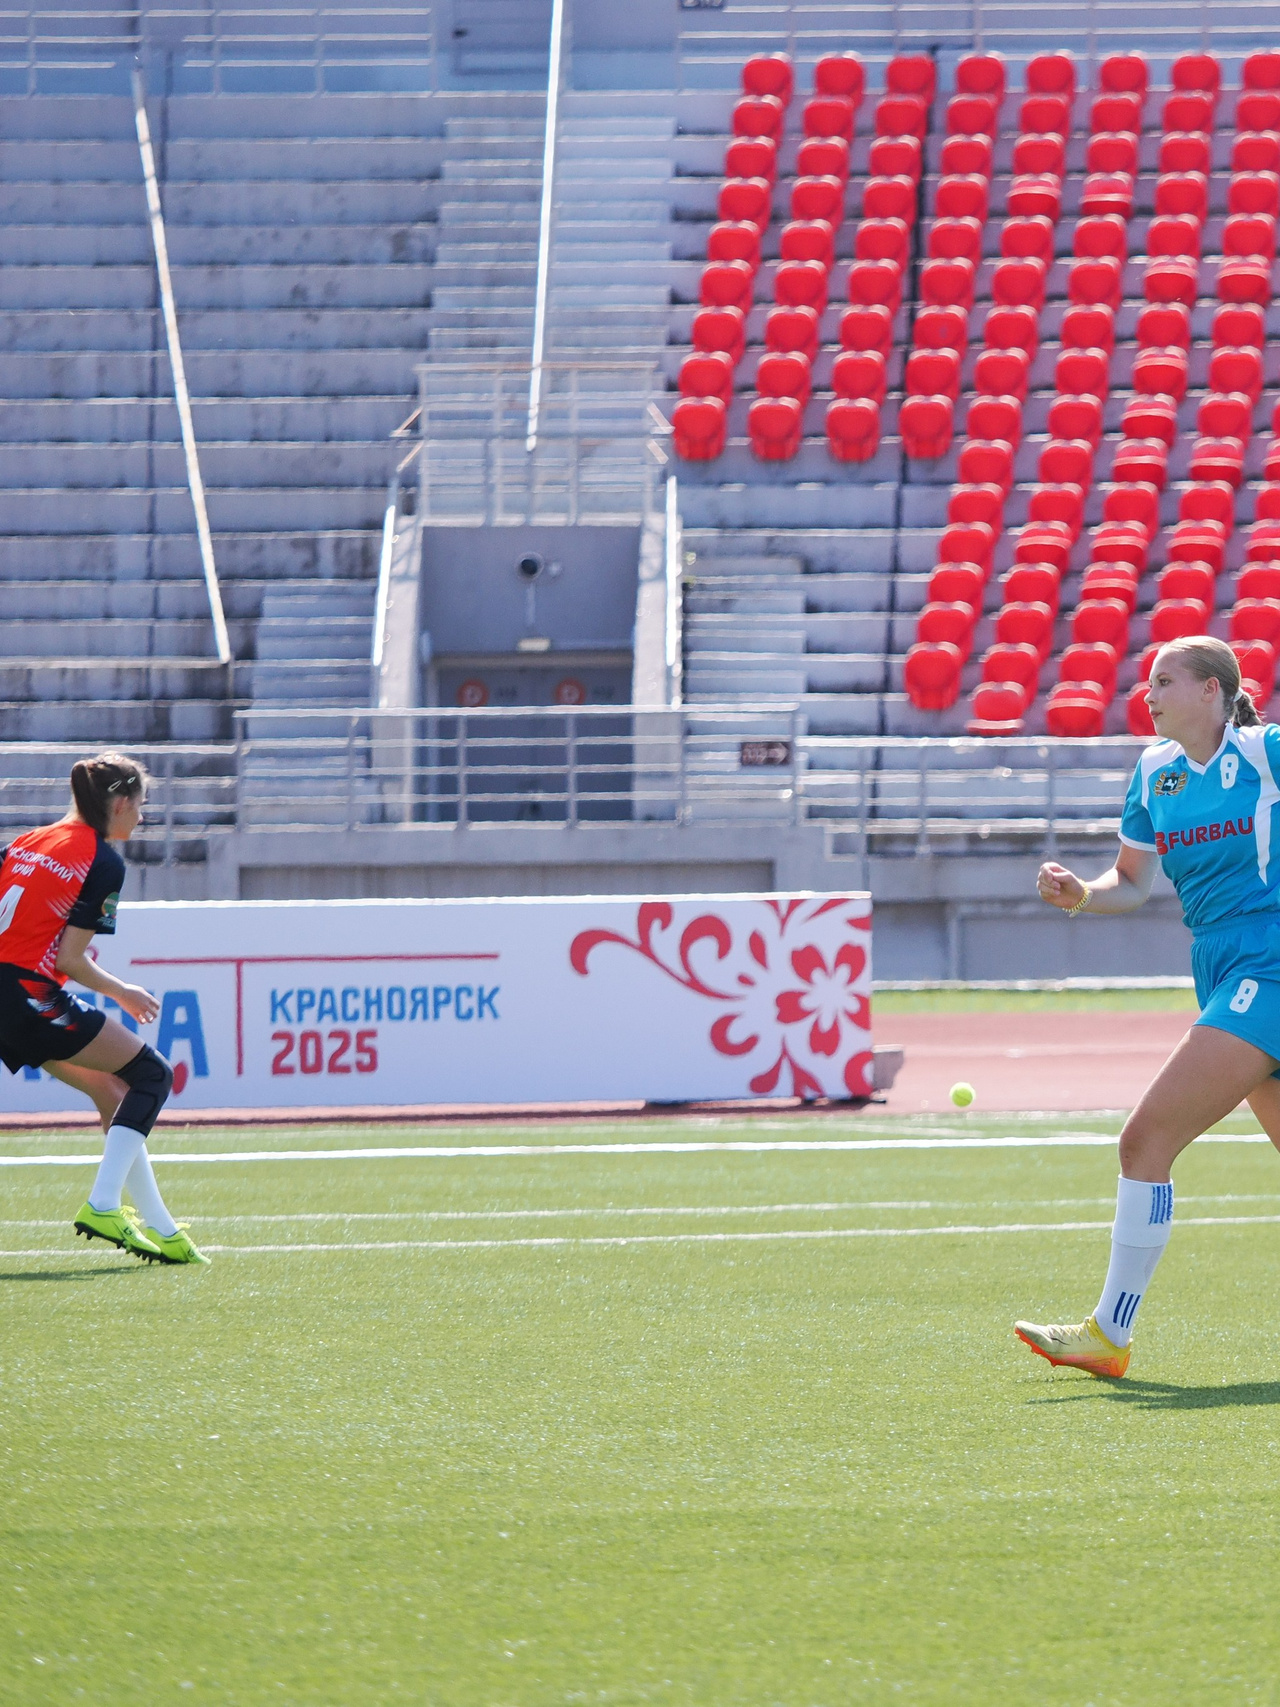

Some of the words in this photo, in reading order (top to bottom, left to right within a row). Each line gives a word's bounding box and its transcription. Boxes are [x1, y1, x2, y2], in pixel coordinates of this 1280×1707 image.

[1220, 753, 1239, 789] 8
[270, 985, 500, 1024] КРАСНОЯРСК
[1229, 978, 1259, 1014] 8
[271, 1030, 378, 1075] 2025
